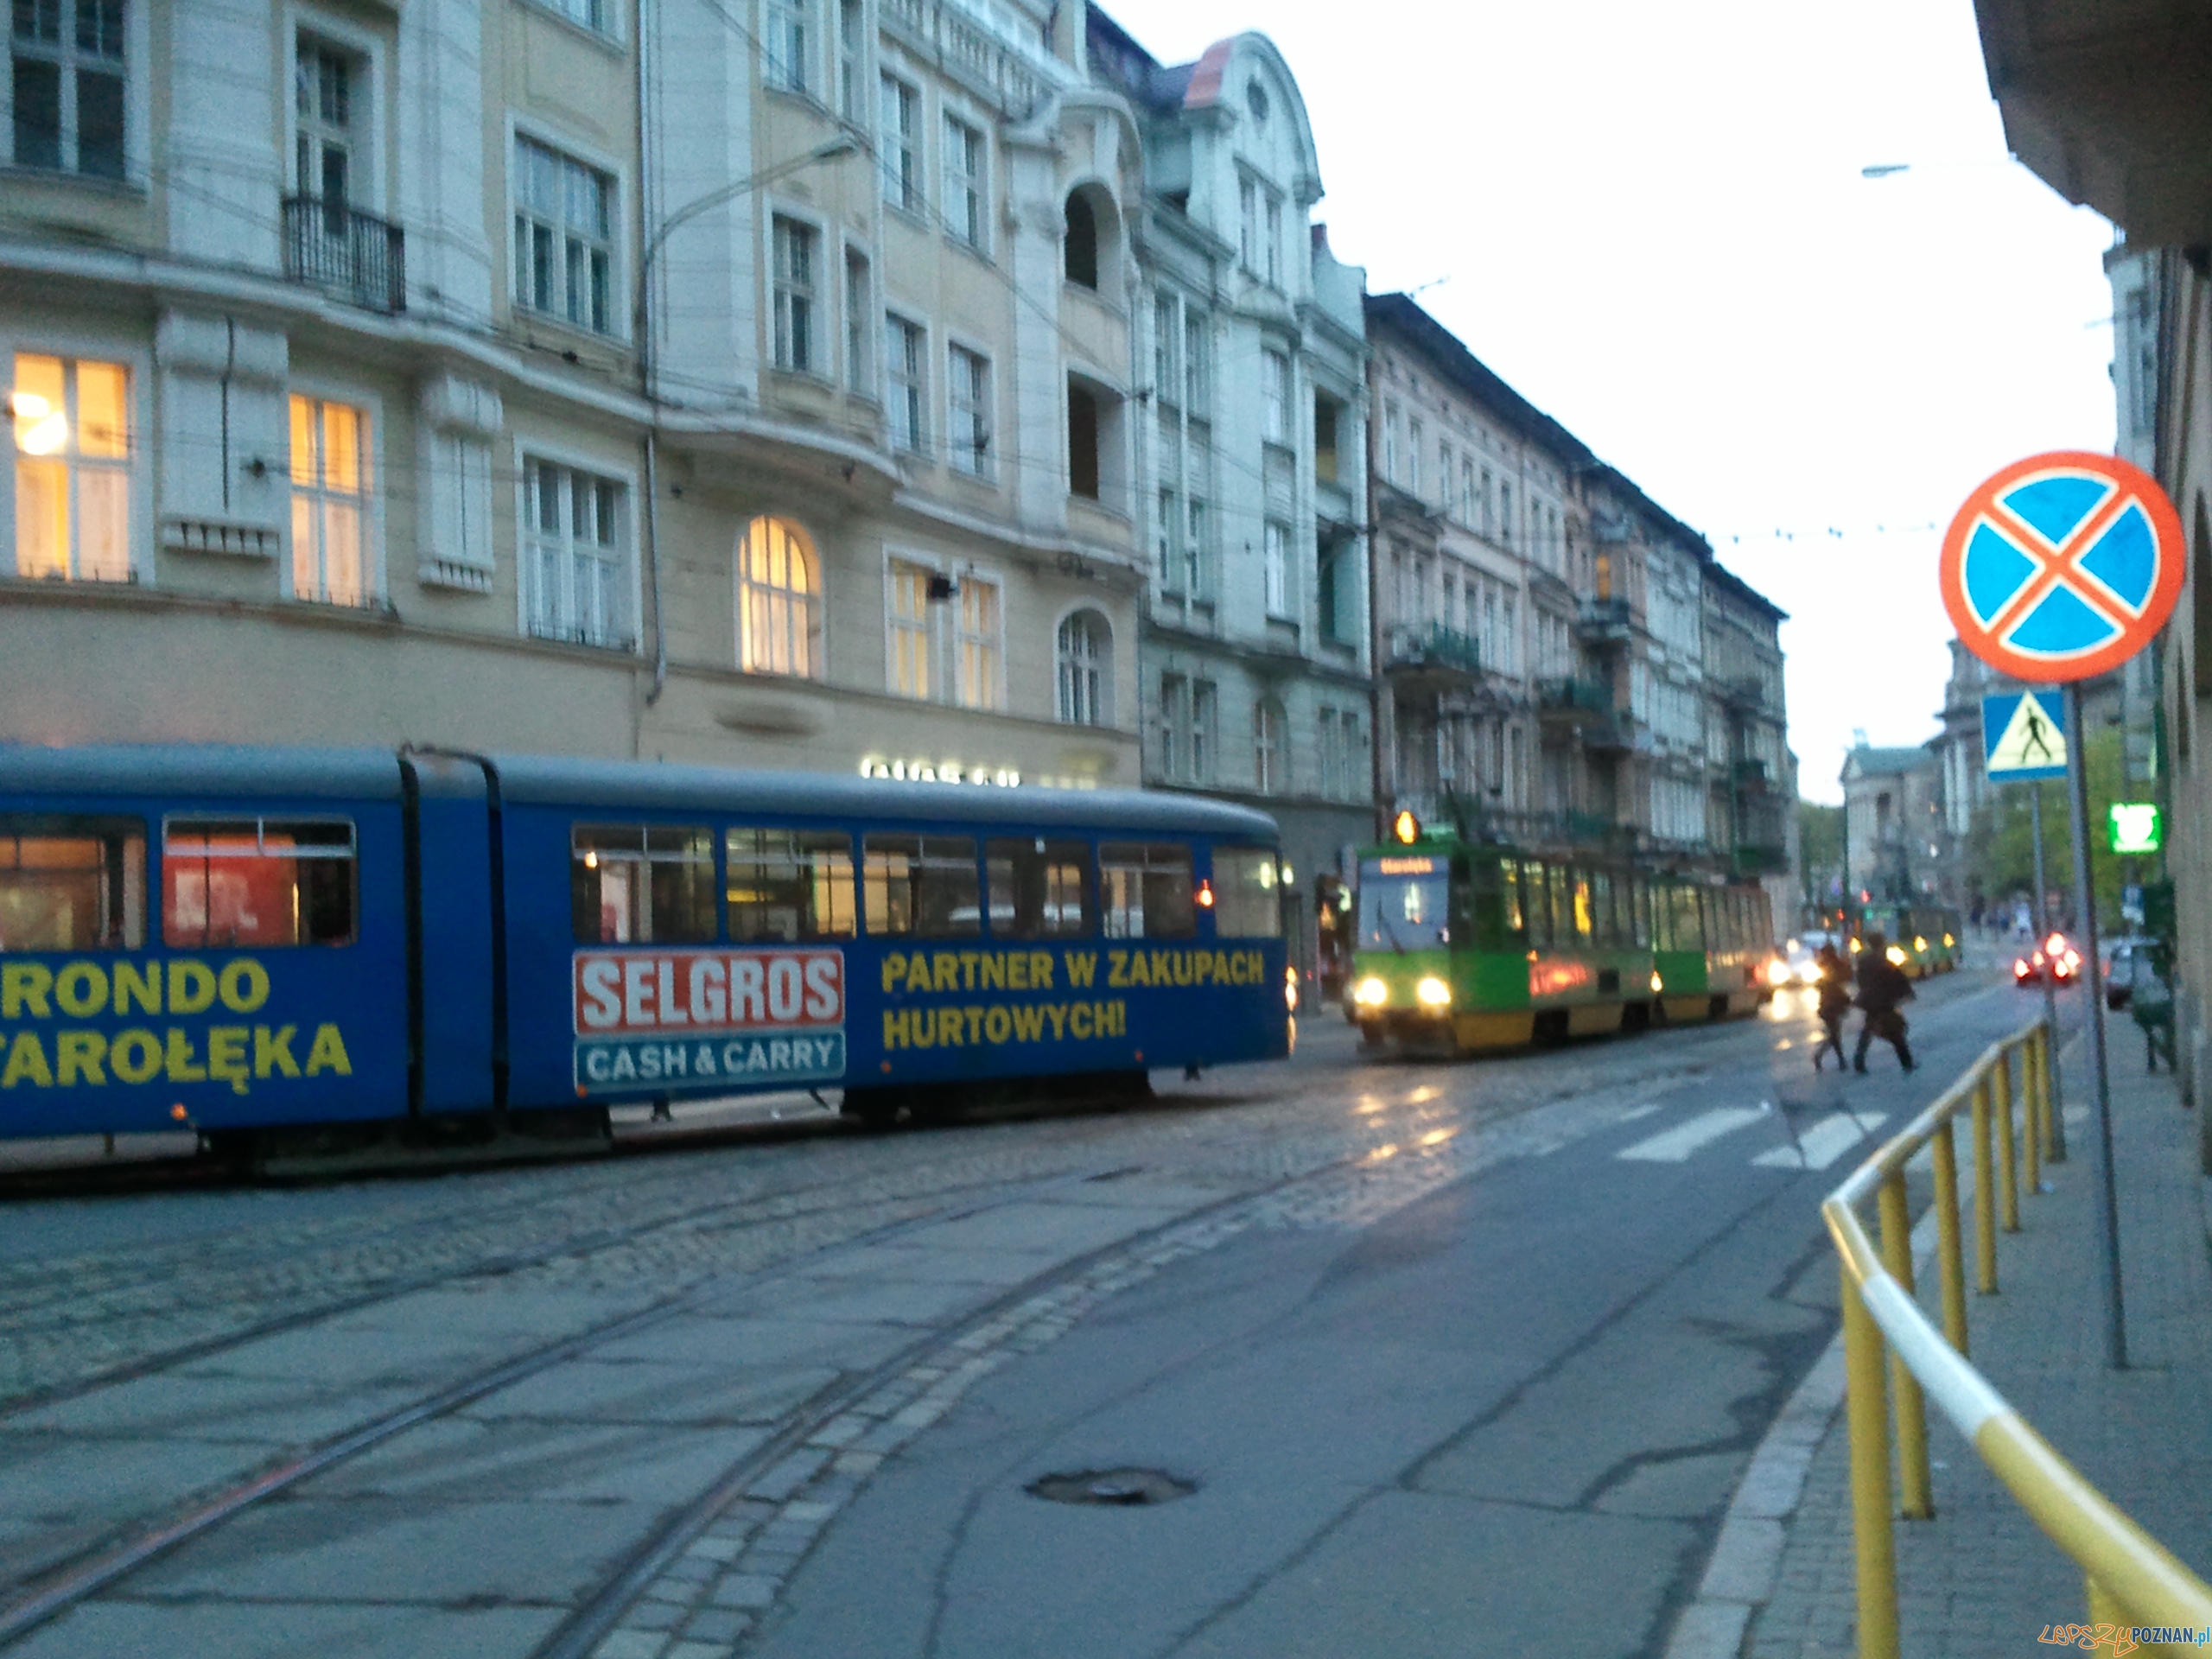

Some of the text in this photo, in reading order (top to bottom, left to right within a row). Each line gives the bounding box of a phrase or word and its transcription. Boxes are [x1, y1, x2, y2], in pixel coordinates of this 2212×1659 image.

[1, 959, 270, 1018] RONDO
[582, 957, 839, 1027] SELGROS
[881, 949, 1264, 993] PARTNER W ZAKUPACH
[883, 1001, 1126, 1051] HURTOWYCH!
[0, 1023, 352, 1096] AROŁĘKA
[587, 1038, 834, 1080] CASH & CARRY
